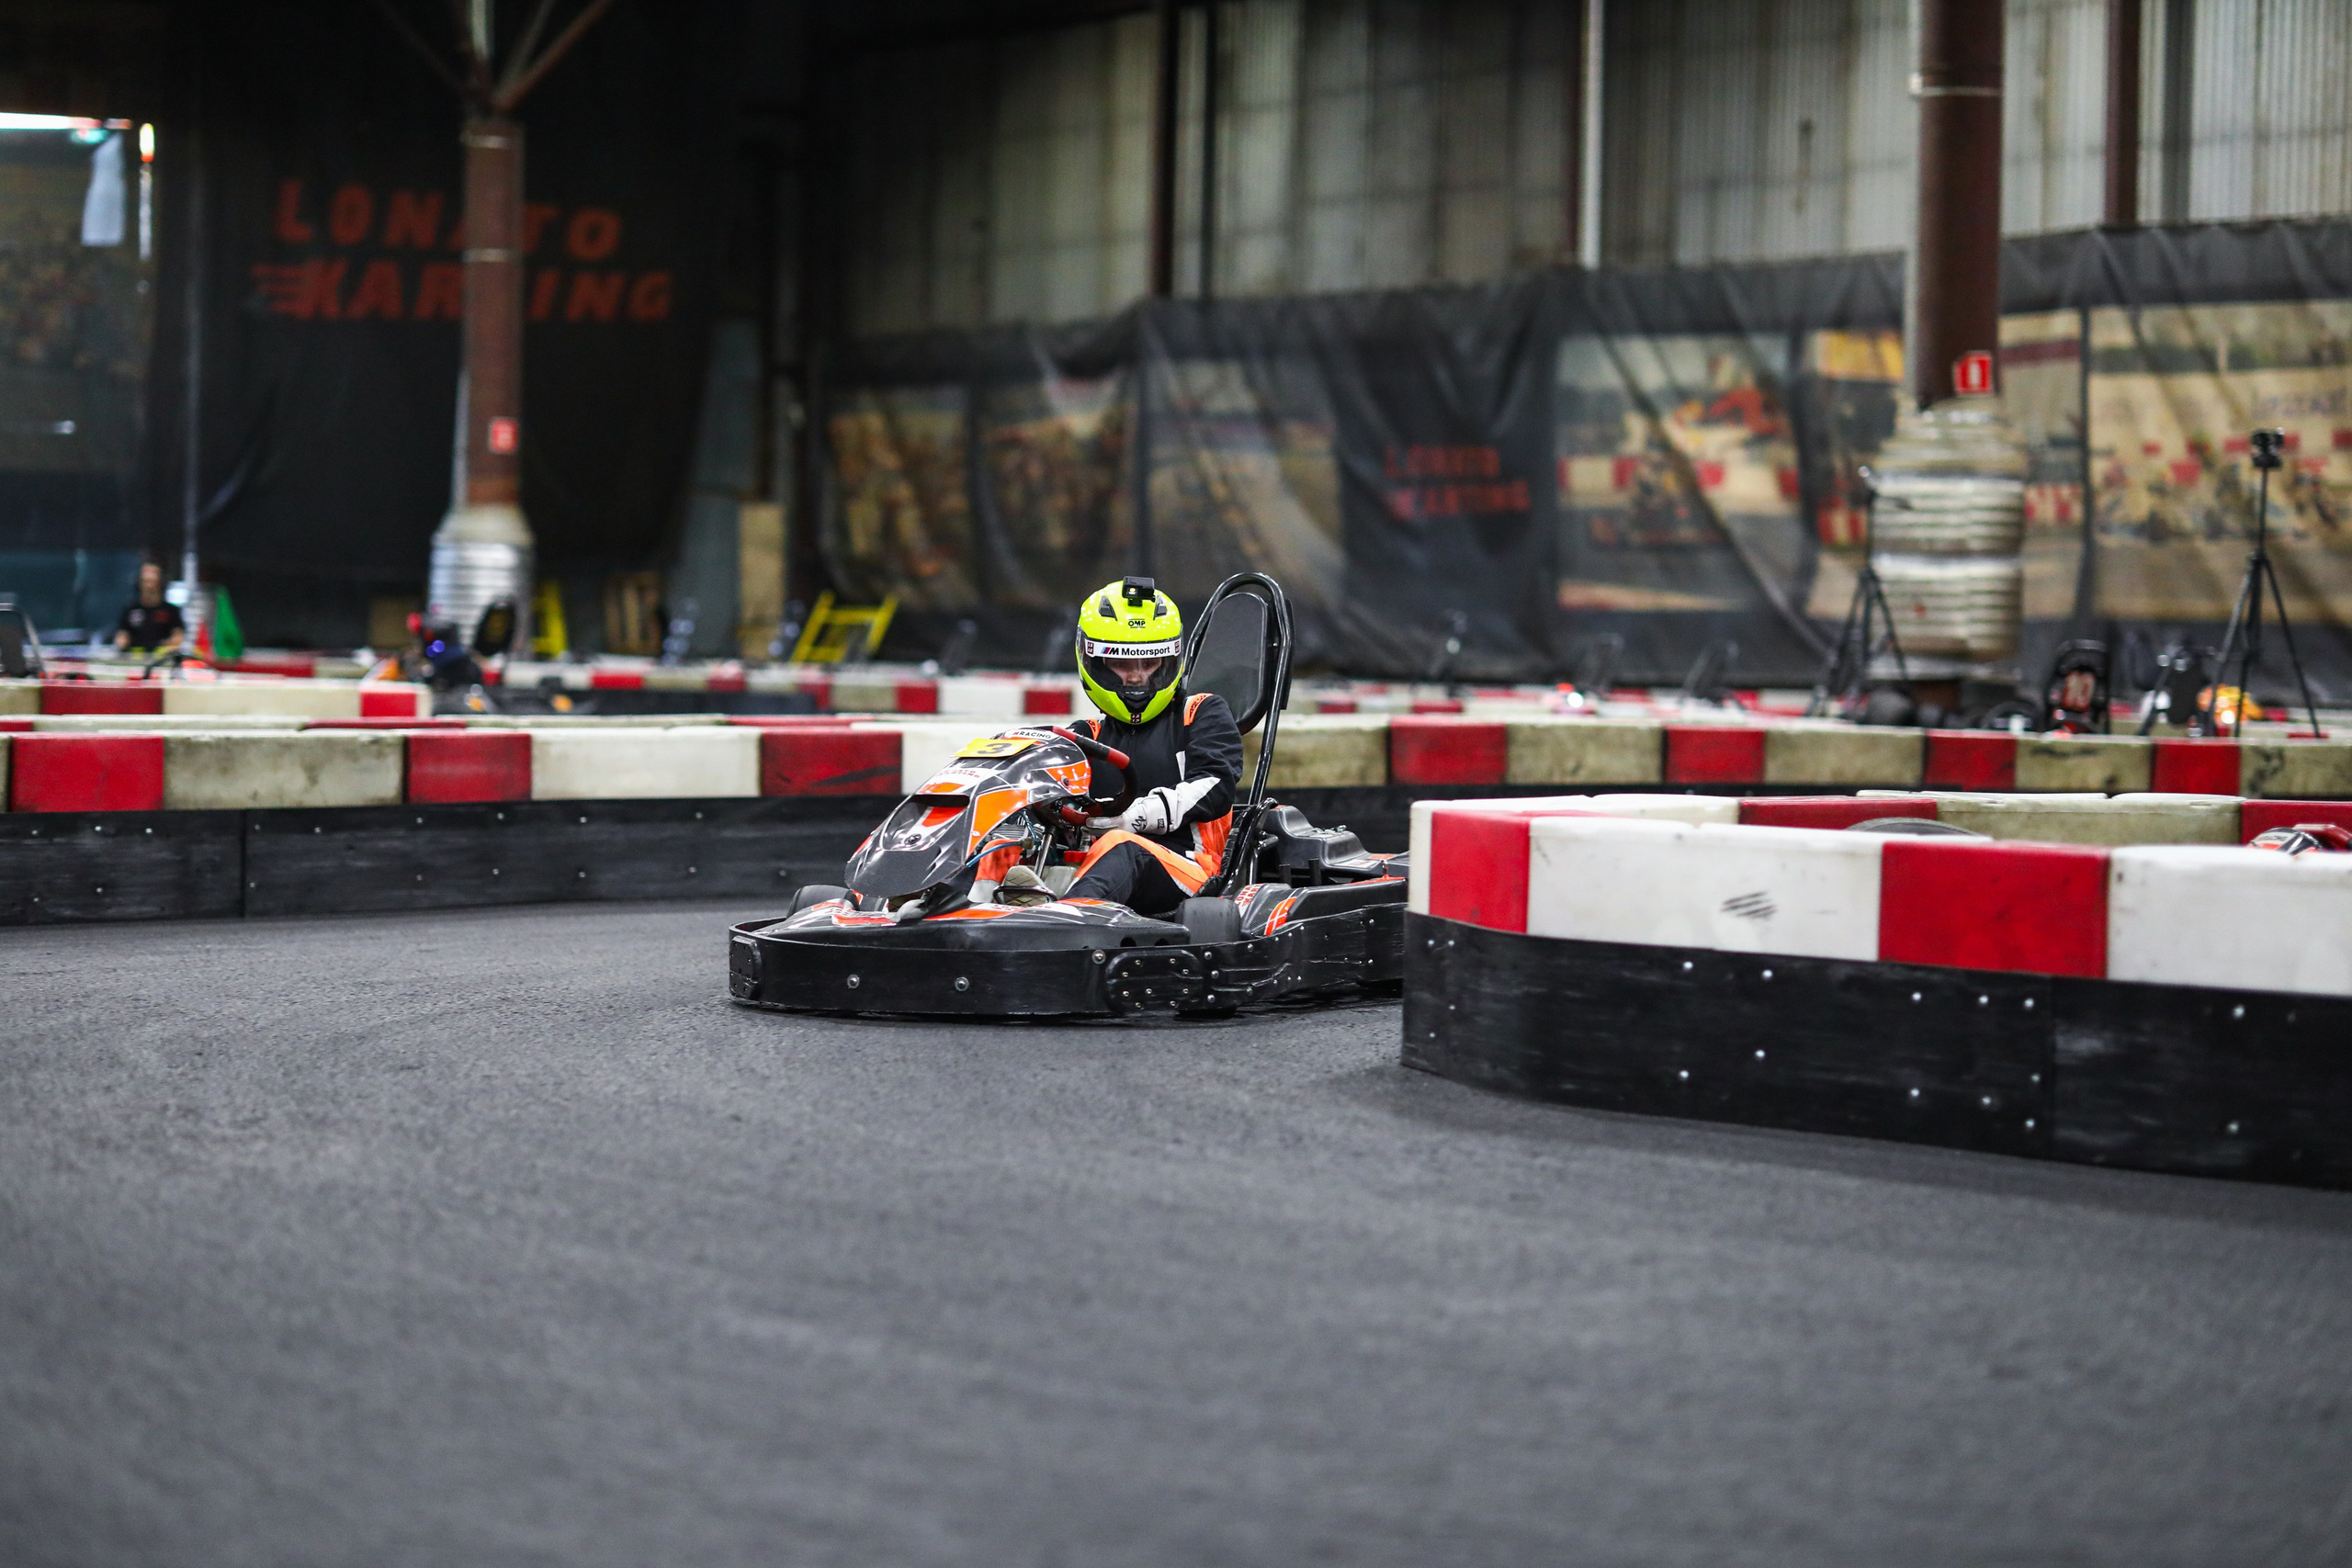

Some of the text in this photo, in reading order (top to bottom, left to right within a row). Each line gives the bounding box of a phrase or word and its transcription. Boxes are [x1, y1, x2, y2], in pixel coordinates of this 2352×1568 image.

[276, 182, 622, 260] LONTO
[266, 261, 673, 320] KARING
[1122, 646, 1170, 656] Motorsport
[977, 742, 1012, 754] 3
[1235, 886, 1252, 906] LONA
